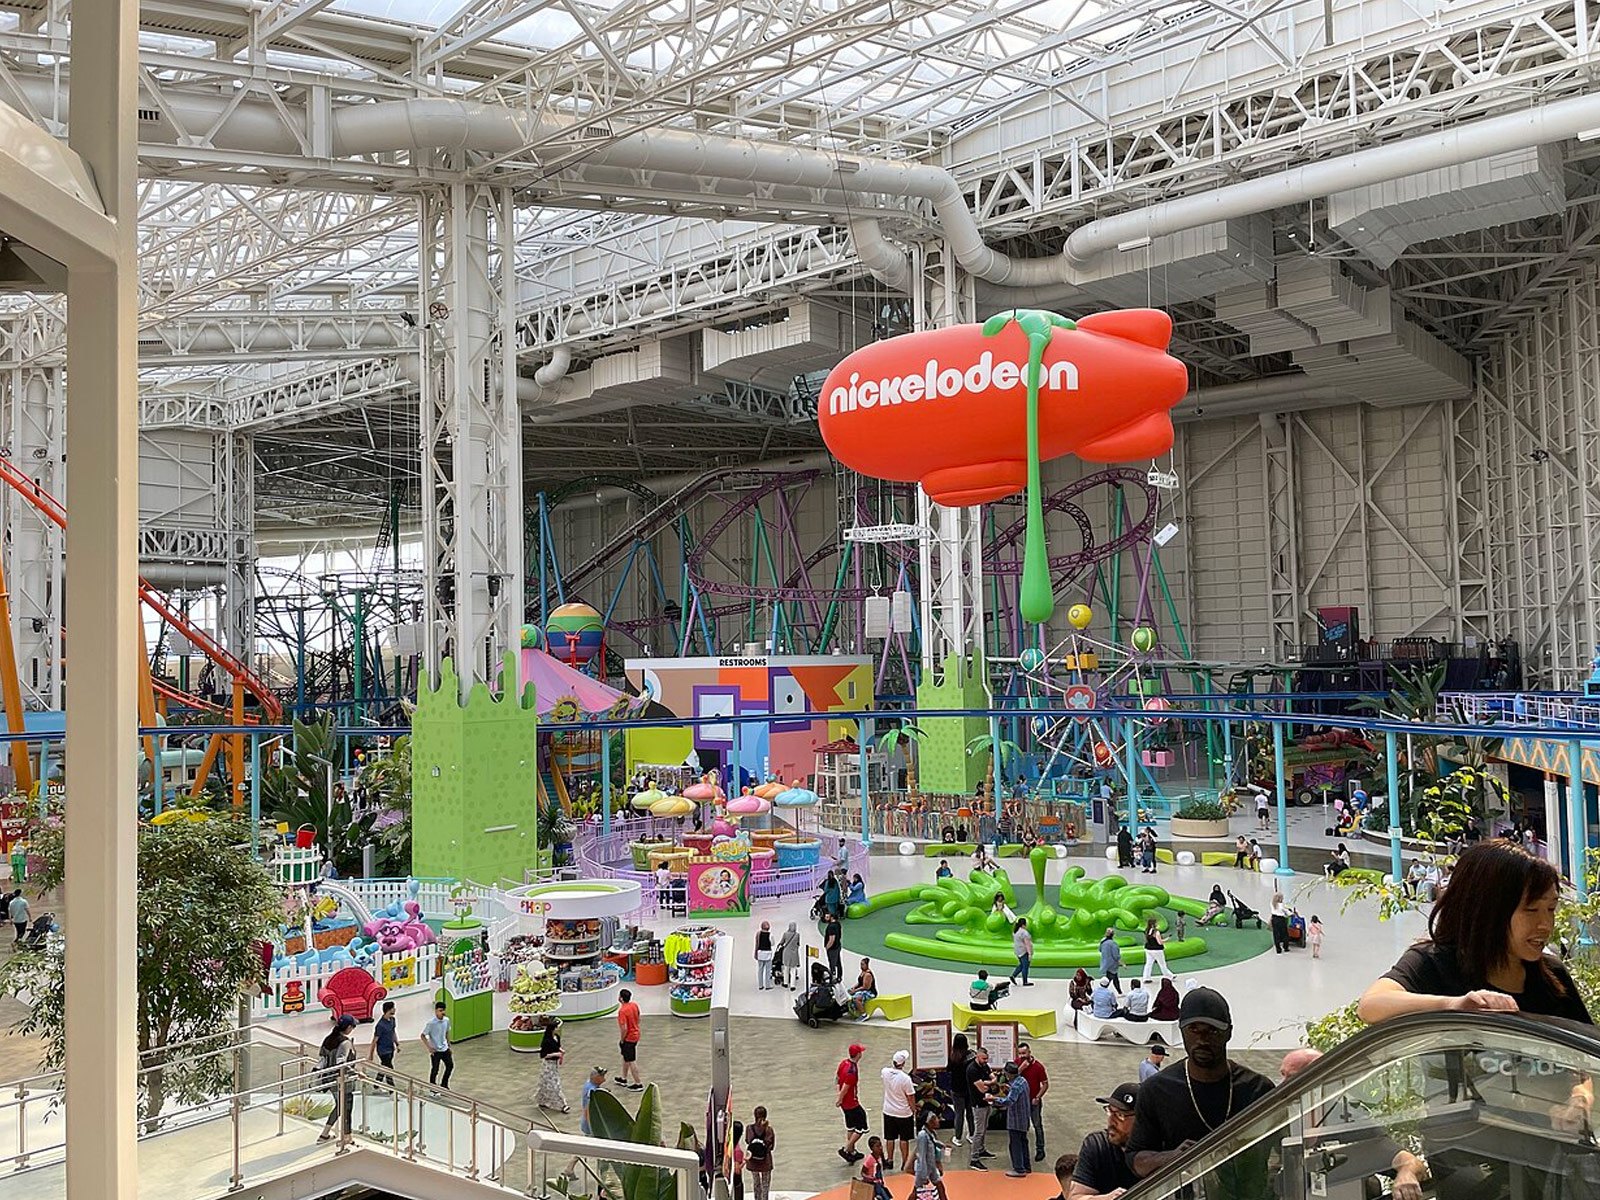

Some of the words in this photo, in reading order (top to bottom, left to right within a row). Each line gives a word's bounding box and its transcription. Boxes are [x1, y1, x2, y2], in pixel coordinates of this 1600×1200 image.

[829, 350, 1079, 415] nickelodeon
[719, 658, 767, 667] RESTROOMS
[520, 900, 552, 914] SHOP
